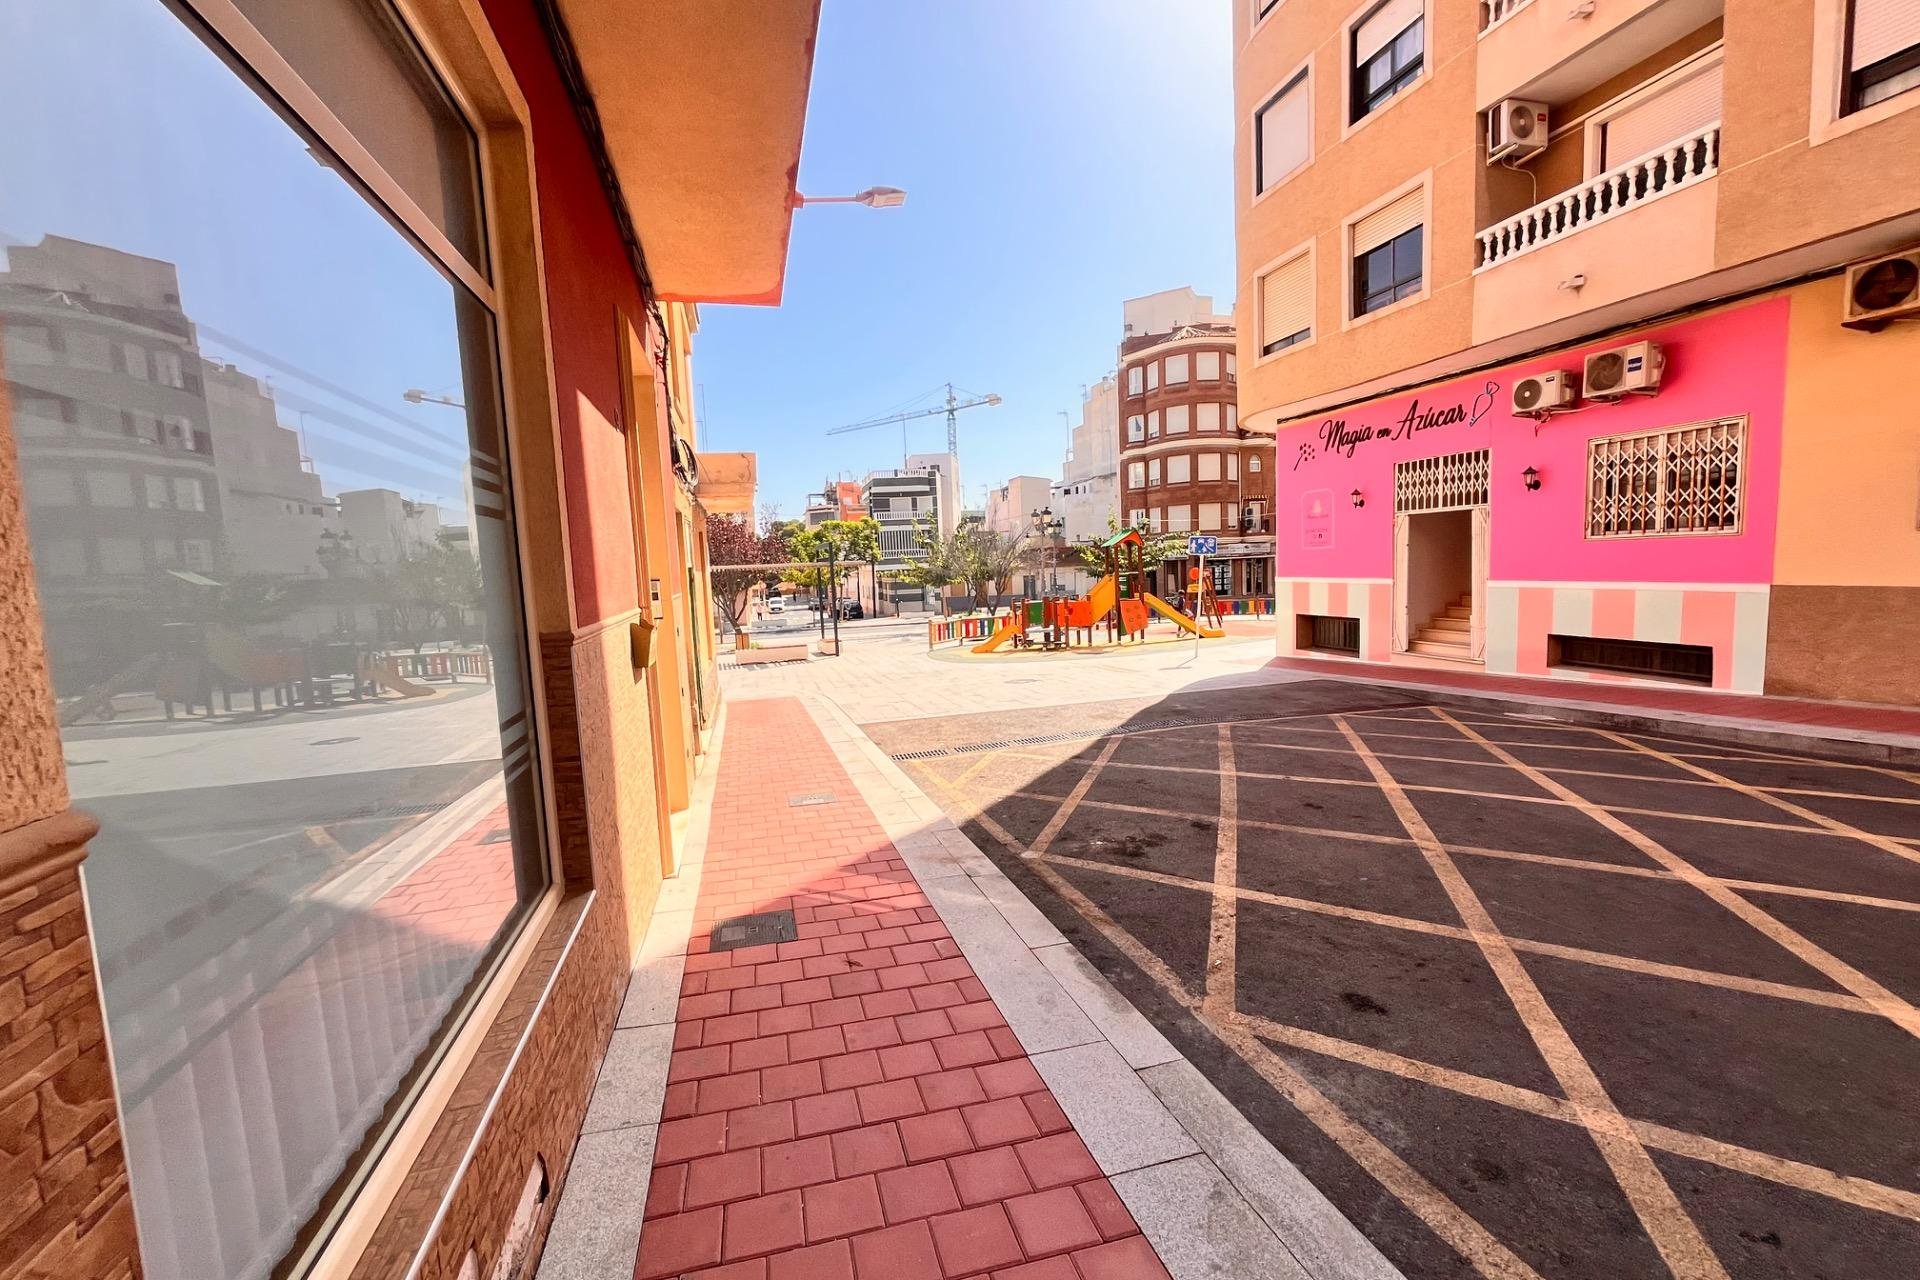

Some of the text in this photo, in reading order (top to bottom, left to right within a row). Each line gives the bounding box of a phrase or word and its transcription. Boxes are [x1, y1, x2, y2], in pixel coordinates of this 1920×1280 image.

[1319, 399, 1467, 458] Magia en Azúcar
